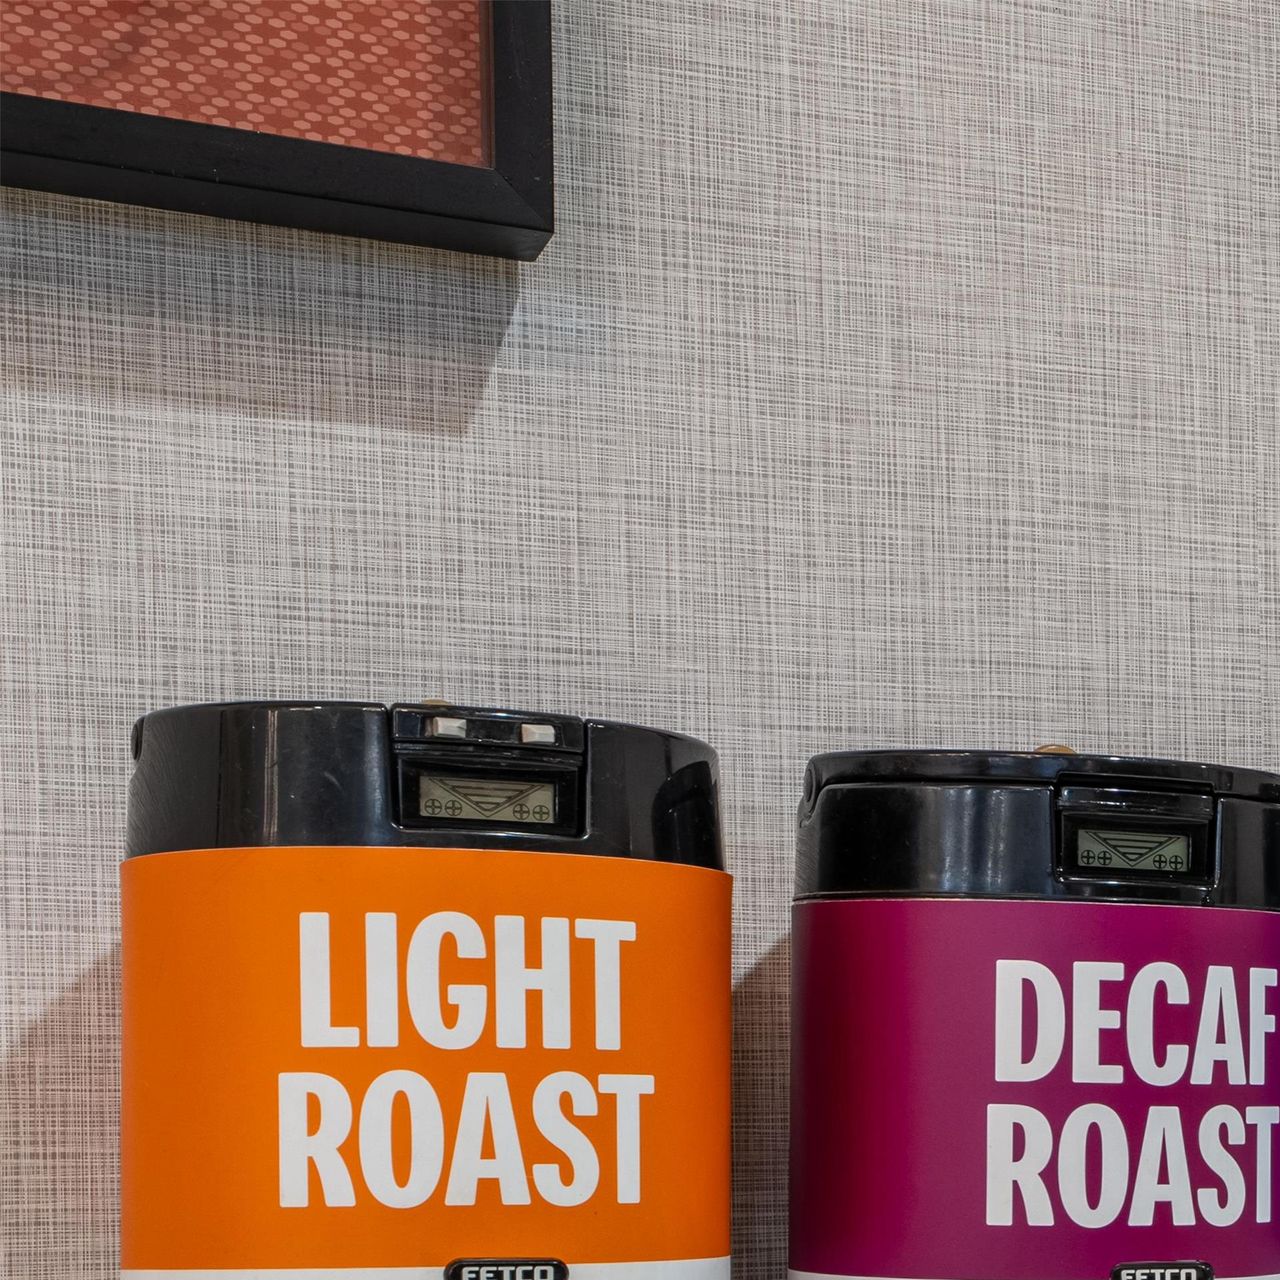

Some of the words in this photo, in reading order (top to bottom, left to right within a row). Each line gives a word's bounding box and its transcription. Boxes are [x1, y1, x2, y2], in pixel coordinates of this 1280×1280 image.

[299, 911, 637, 1051] LIGHT
[994, 959, 1278, 1087] DECAF
[278, 1069, 655, 1209] ROAST
[985, 1102, 1280, 1229] ROAST
